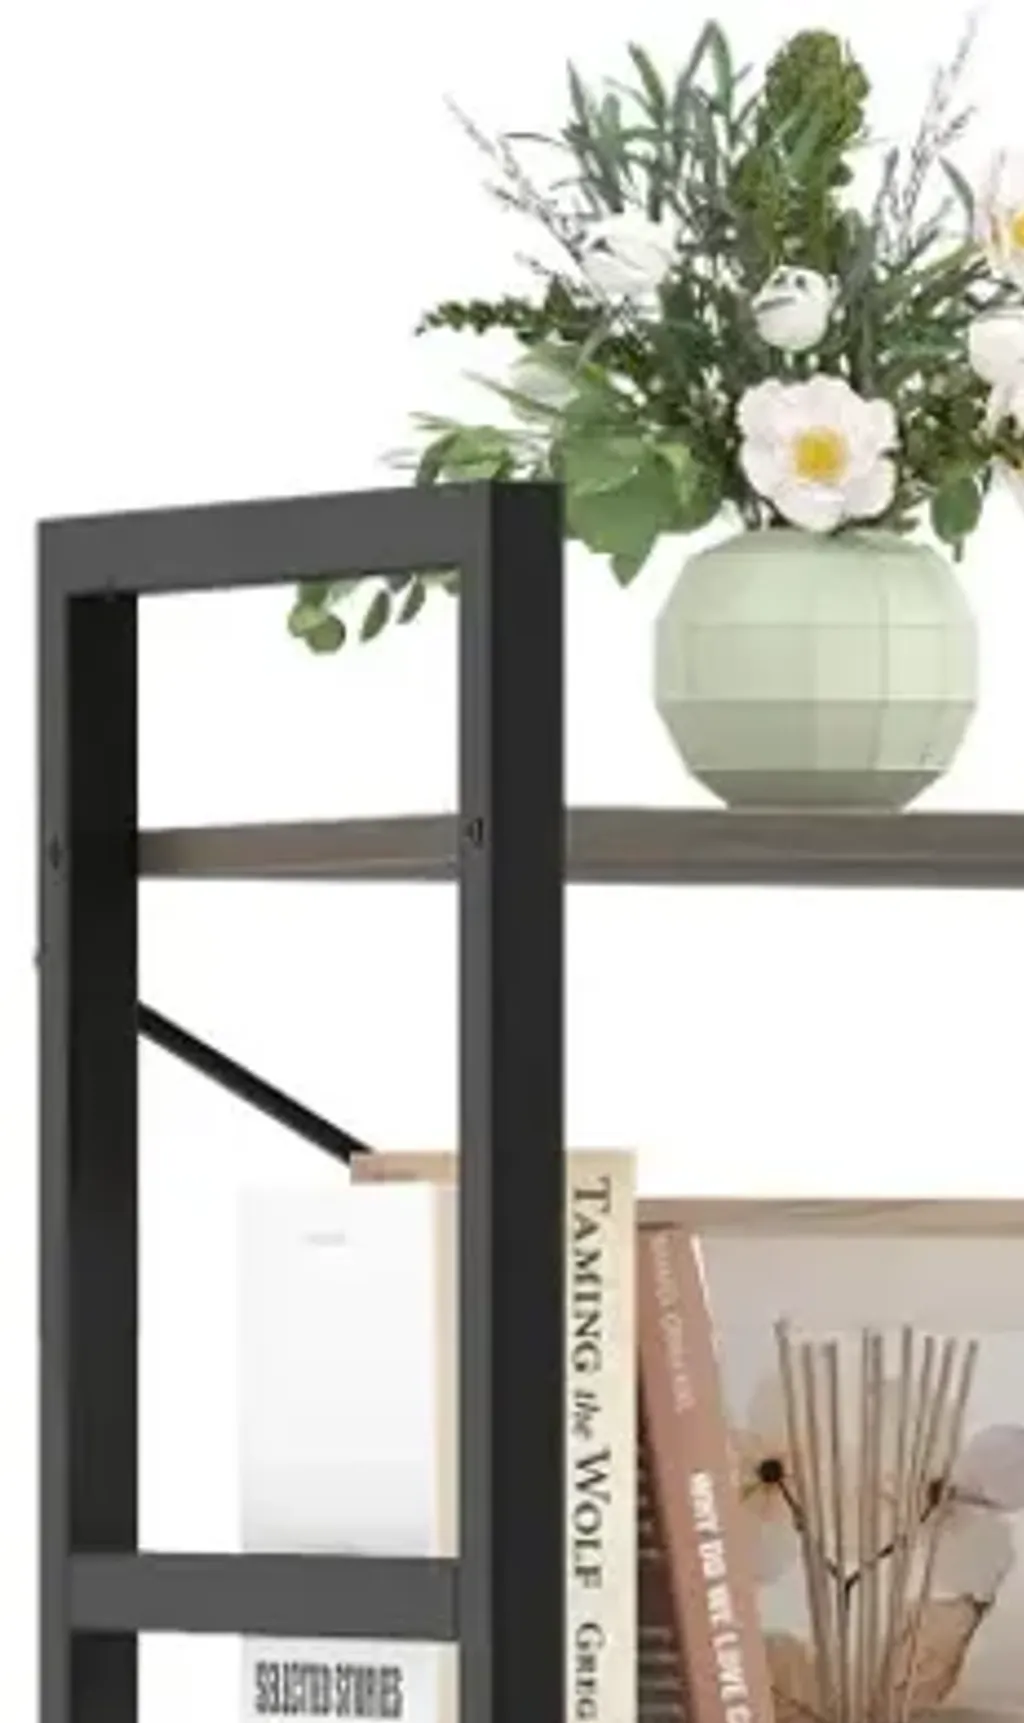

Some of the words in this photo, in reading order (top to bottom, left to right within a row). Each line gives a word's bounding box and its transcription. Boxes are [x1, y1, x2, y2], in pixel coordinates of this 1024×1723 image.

[571, 1175, 612, 1374] TAMING
[572, 1389, 603, 1441] the
[571, 1442, 612, 1590] WOLF
[690, 1472, 719, 1532] WHY
[698, 1538, 727, 1578] DO
[707, 1583, 734, 1626] WE
[573, 1621, 606, 1721] GREG
[711, 1630, 748, 1701] LOVE
